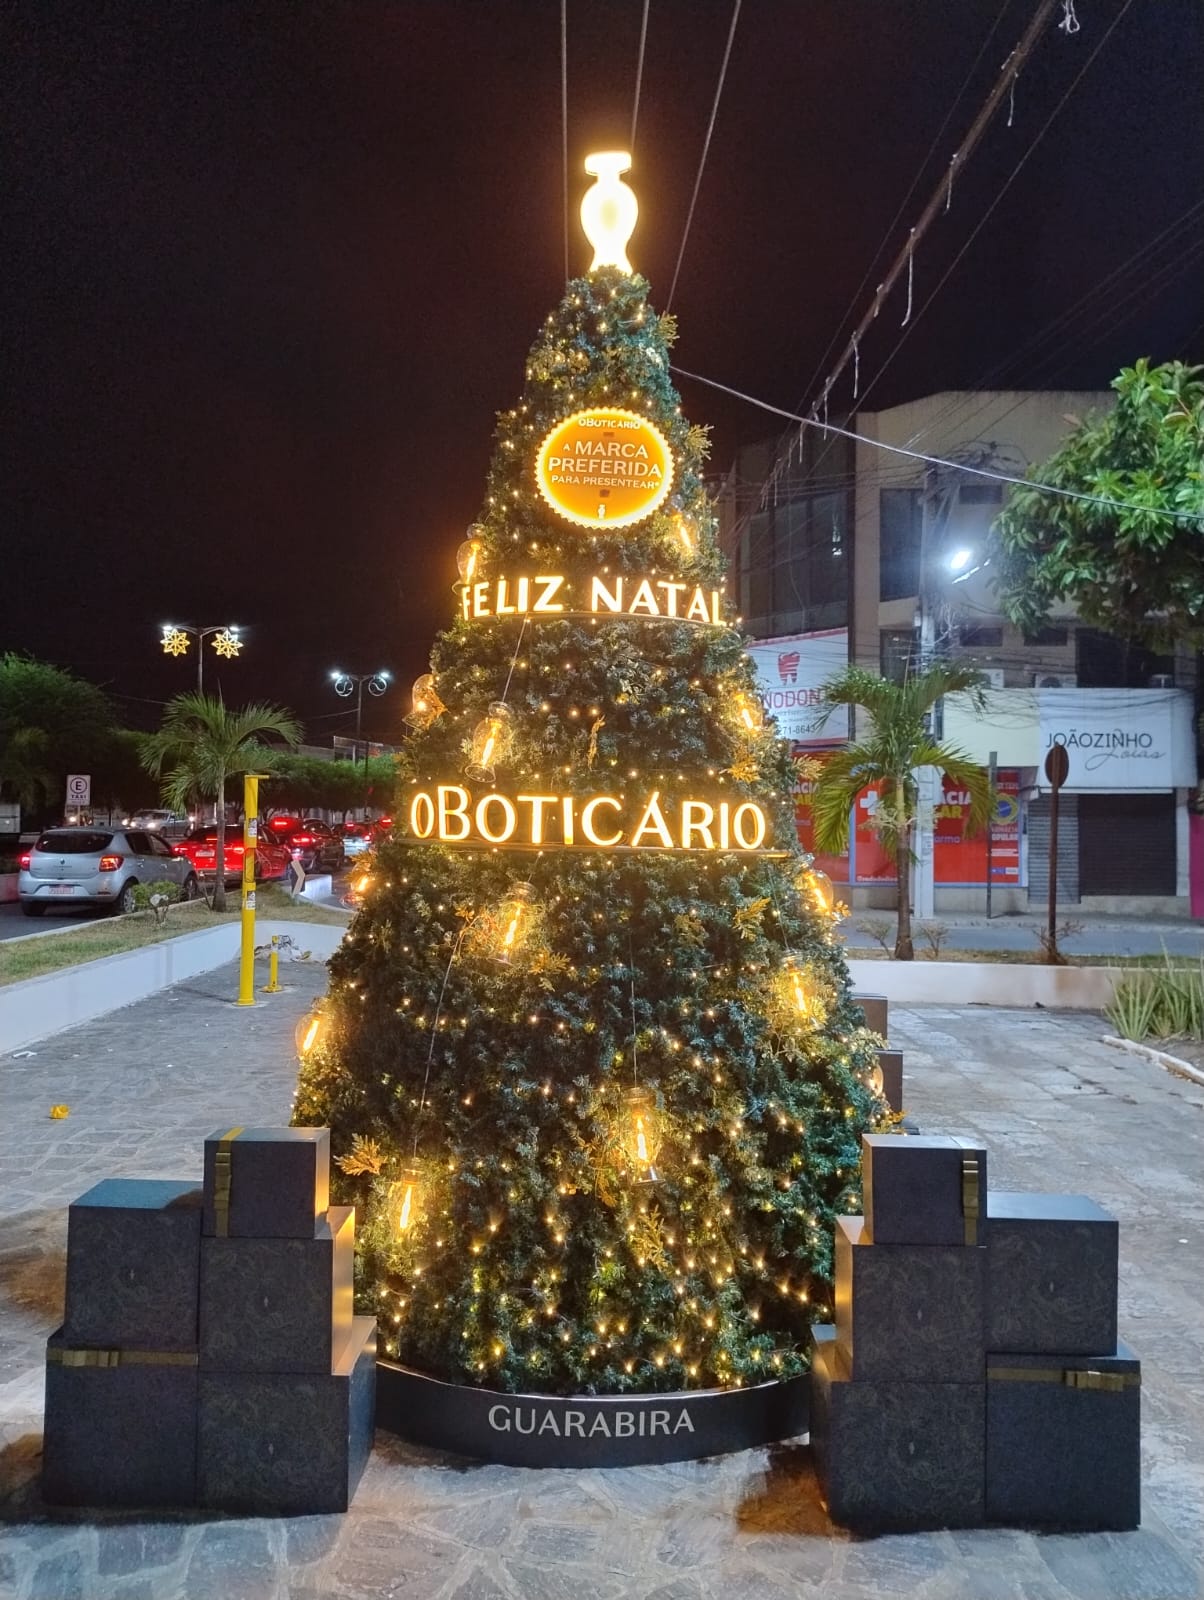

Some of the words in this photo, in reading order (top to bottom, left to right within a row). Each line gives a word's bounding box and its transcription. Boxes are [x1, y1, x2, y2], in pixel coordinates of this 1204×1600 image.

[563, 443, 571, 451] A
[575, 440, 649, 459] MARCA
[548, 457, 662, 478] PREFERIDA
[551, 474, 580, 484] PARA
[461, 575, 564, 621] FELIZ
[591, 575, 727, 627] NATAL
[1046, 728, 1153, 749] JOÃOZINHO
[75, 780, 82, 791] E
[410, 786, 766, 850] OBOTICÁRIO
[488, 1404, 696, 1438] GUARABIRA
